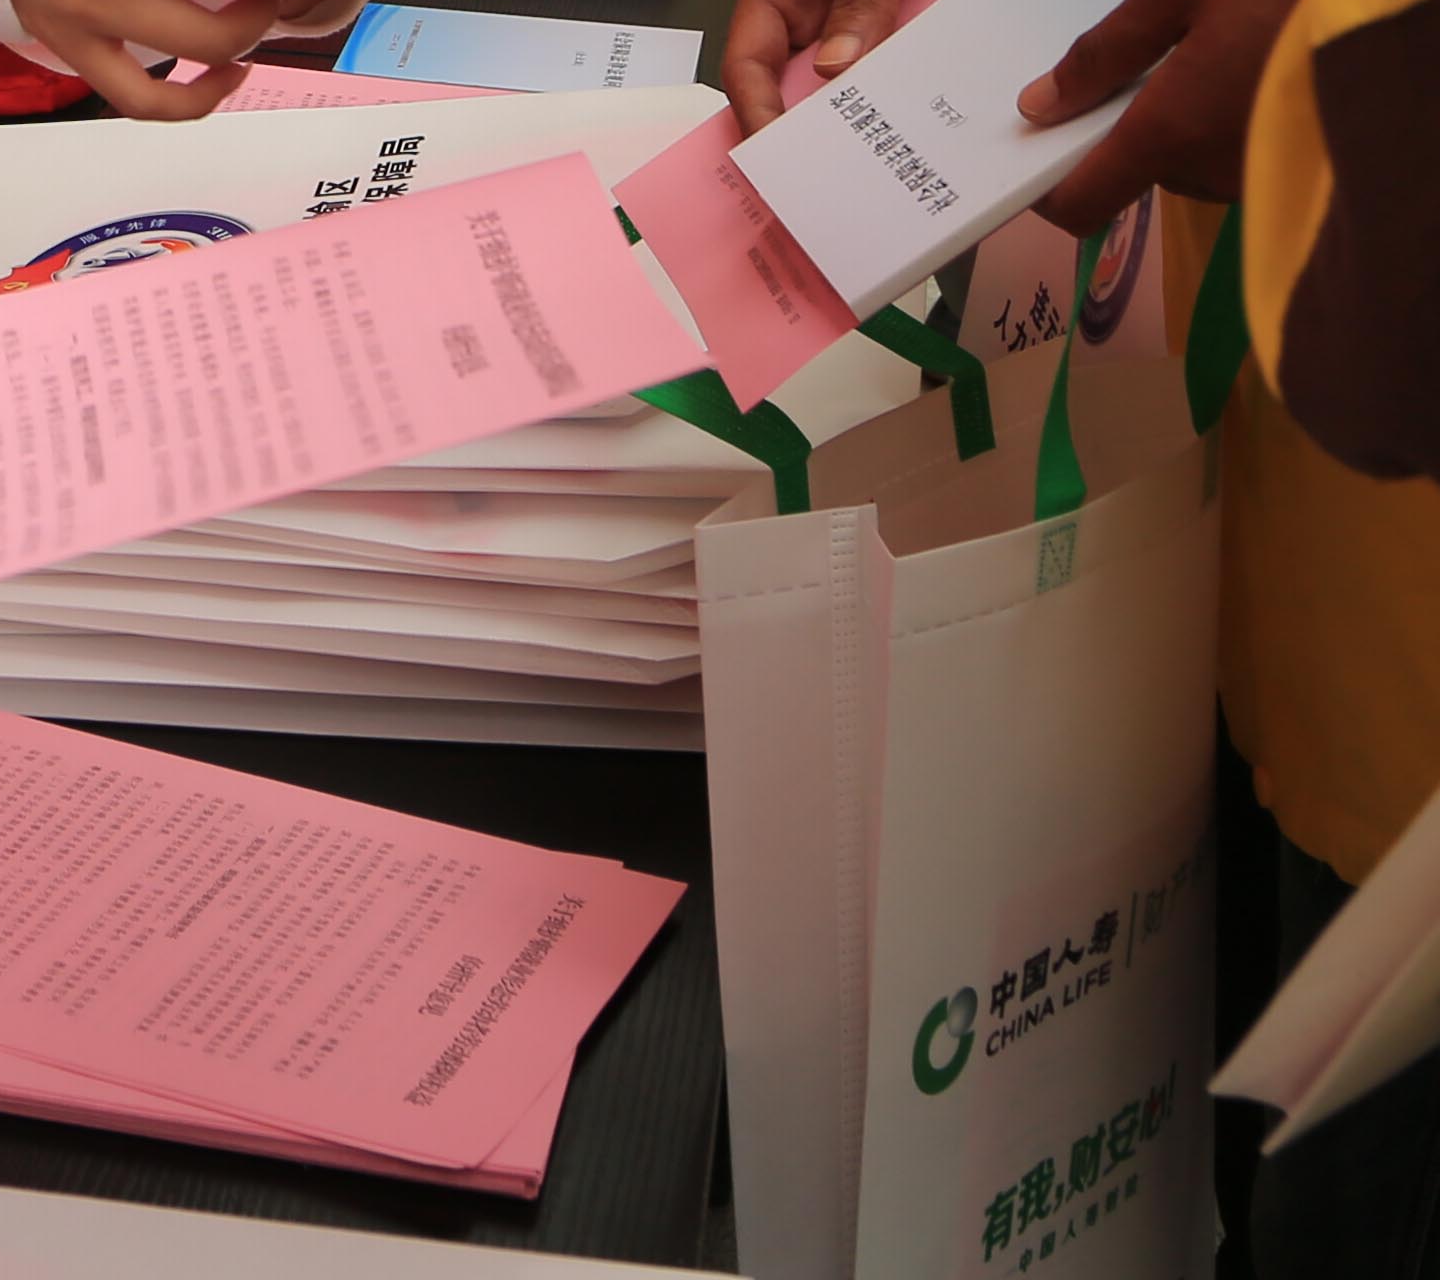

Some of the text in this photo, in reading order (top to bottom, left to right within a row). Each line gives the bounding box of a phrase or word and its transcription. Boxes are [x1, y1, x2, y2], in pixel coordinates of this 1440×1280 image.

[828, 83, 962, 219] 社会保障法律法规问答
[985, 959, 1113, 1058] CHINA LIFE
[990, 908, 1120, 1019] 中国人寿
